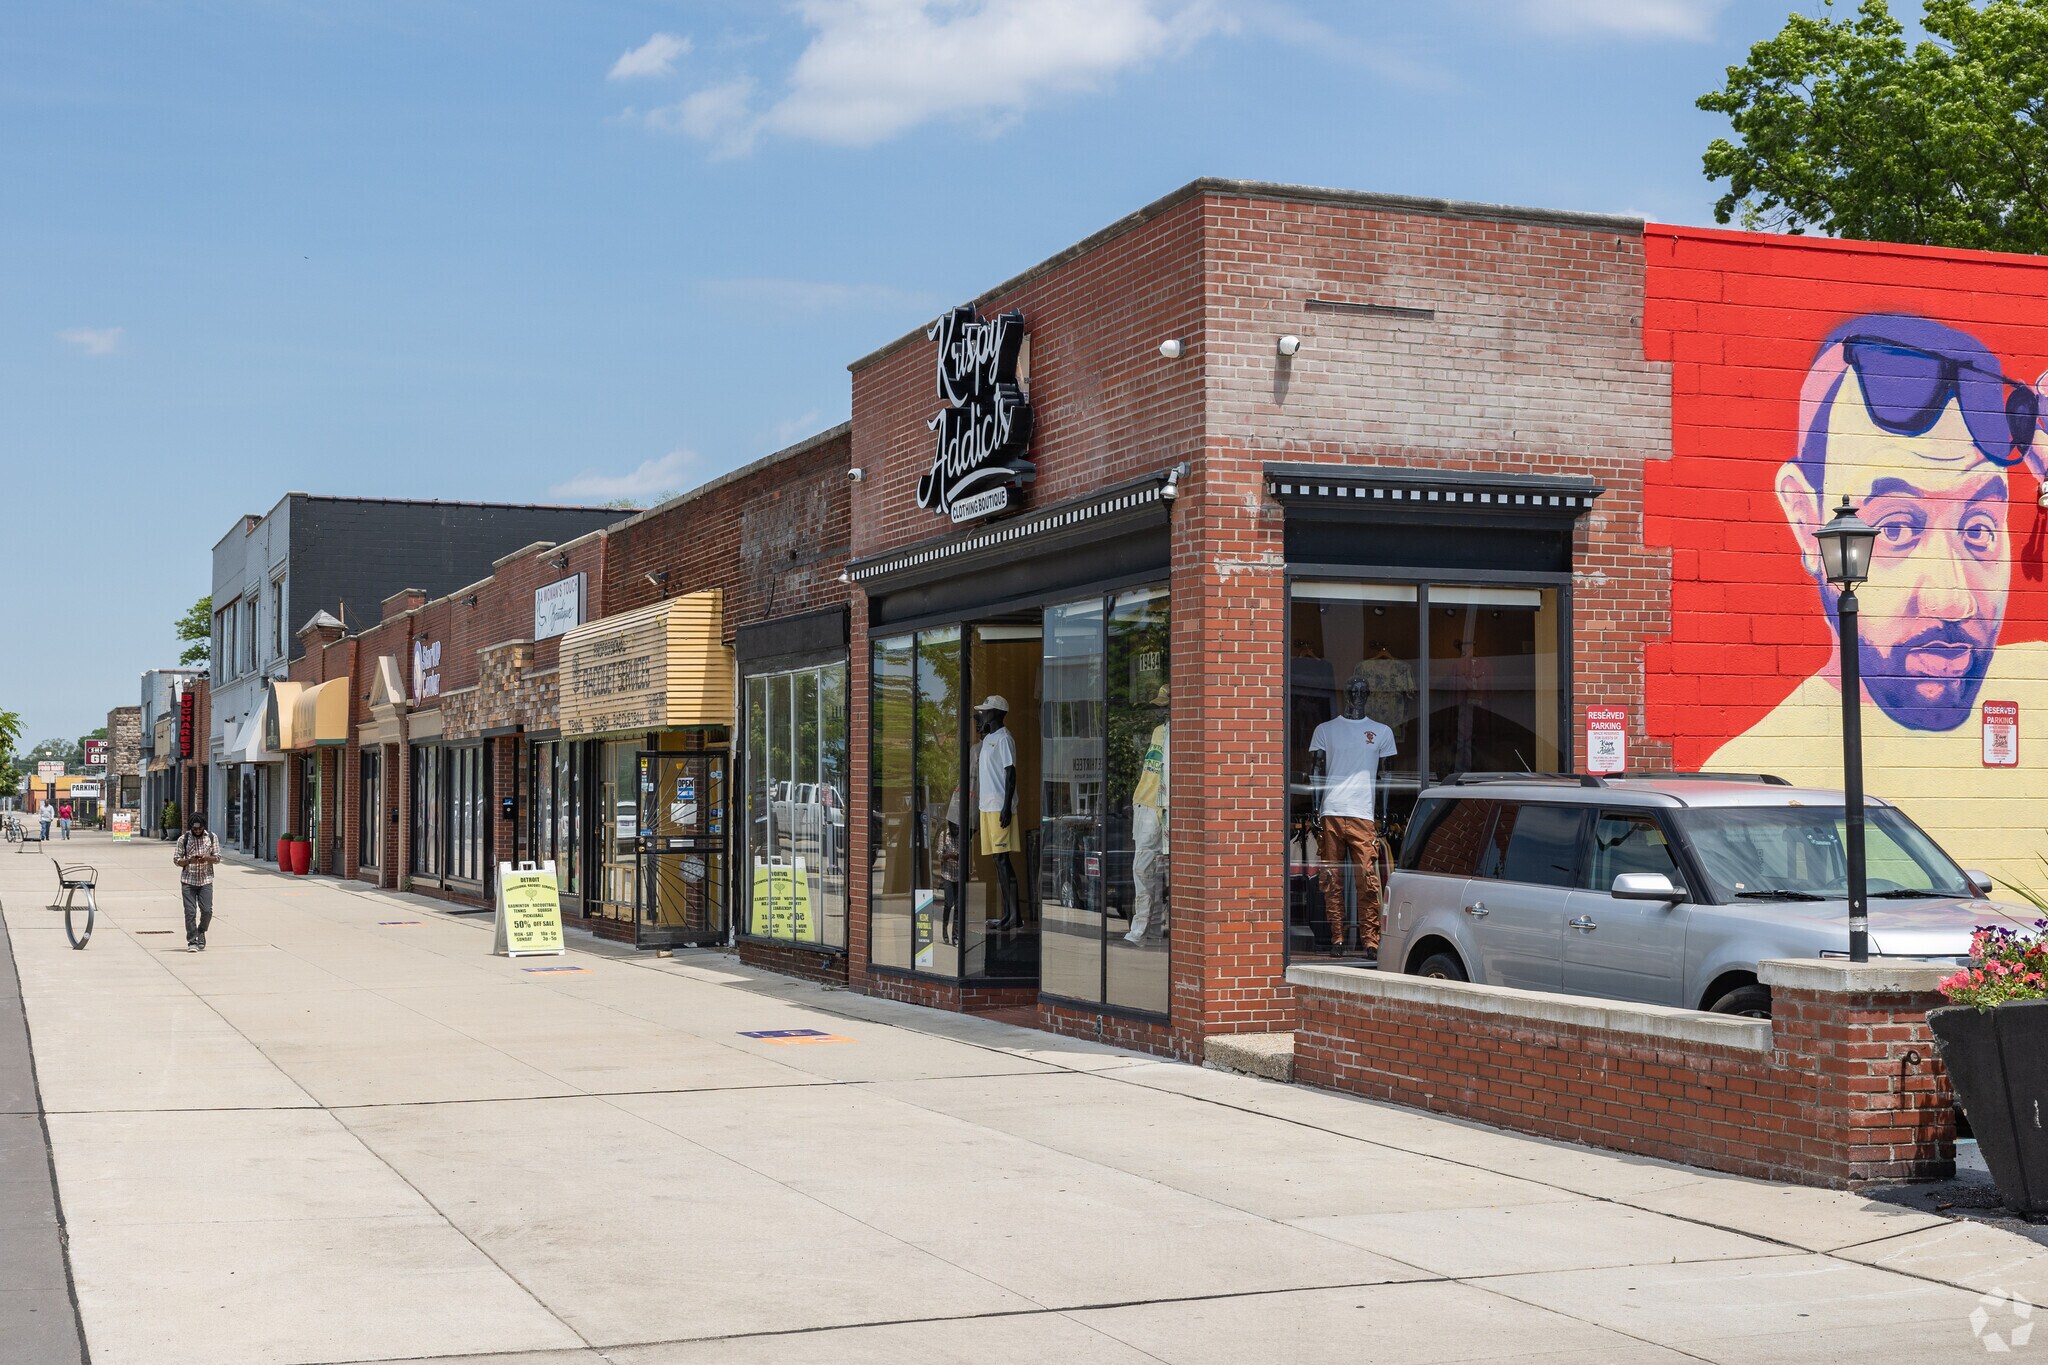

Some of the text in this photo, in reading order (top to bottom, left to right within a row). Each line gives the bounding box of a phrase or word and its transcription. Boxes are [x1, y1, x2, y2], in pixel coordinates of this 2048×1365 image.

[927, 306, 1009, 408] Krispy
[917, 382, 1015, 515] Addicts
[952, 490, 1006, 520] CLOTHING BOUTIQUE
[544, 584, 562, 602] WOMAN'S
[563, 578, 578, 596] TOUCH
[1140, 651, 1160, 671] 19434
[1984, 706, 2017, 715] RESERVED
[1588, 711, 1625, 720] RESERVED
[180, 693, 193, 757] BUCHAREST
[1986, 716, 2014, 725] PARKING
[1591, 722, 1622, 730] PARKING
[678, 779, 694, 788] OPEN
[506, 884, 527, 893] PROFESSIONAL
[513, 920, 531, 929] 50%
